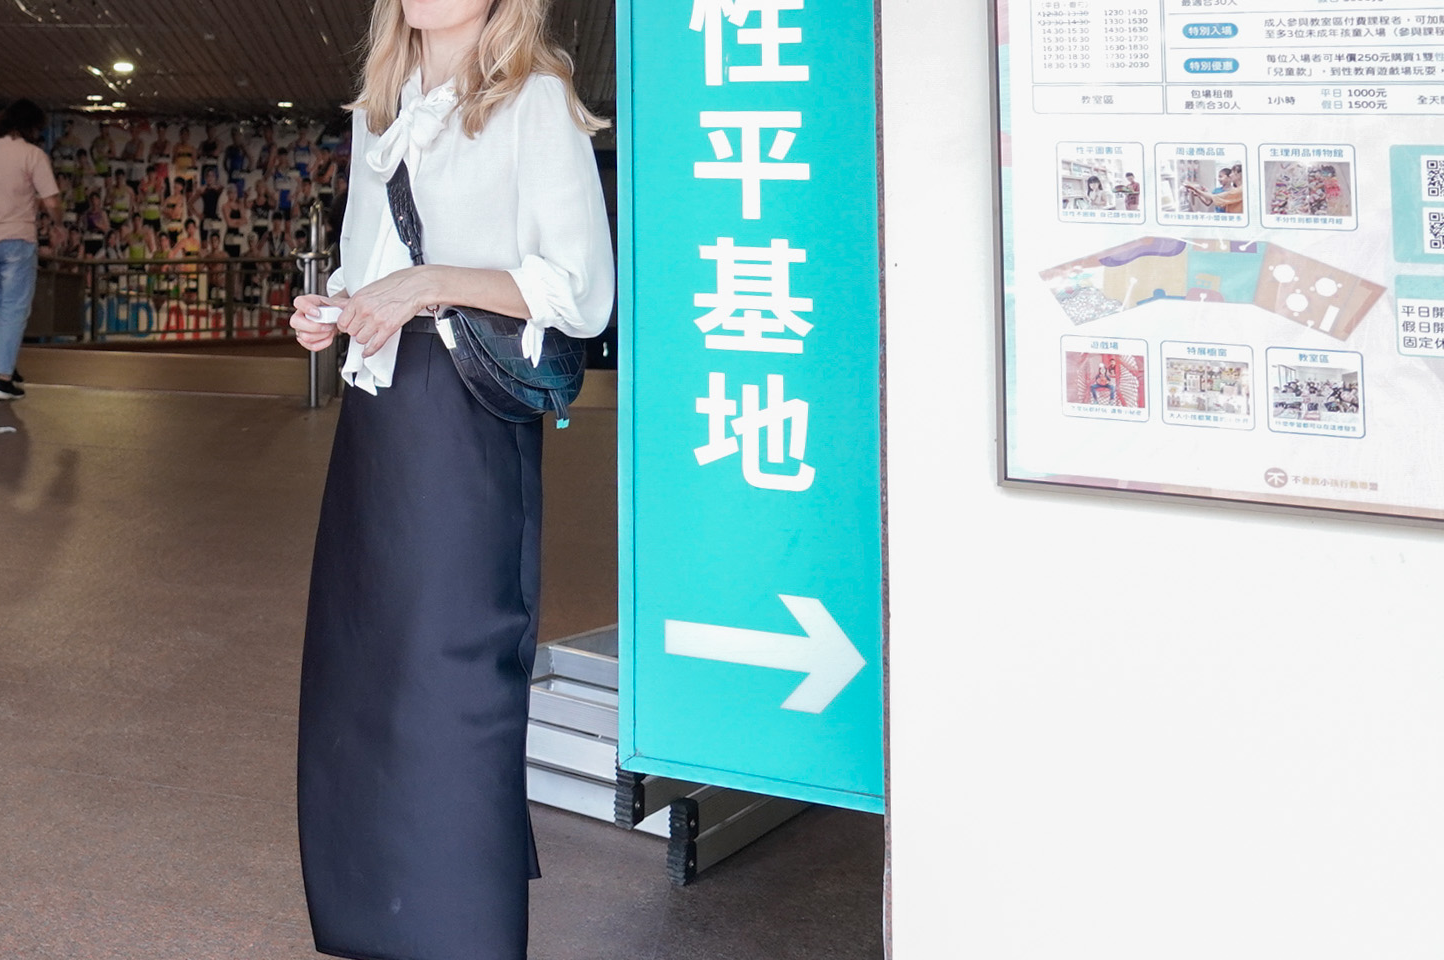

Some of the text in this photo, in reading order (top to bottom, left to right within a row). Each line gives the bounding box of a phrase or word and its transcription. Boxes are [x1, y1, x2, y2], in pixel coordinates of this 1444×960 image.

[1188, 26, 1232, 36] 特別入場
[1189, 61, 1233, 71] 特別優惠
[1191, 89, 1233, 99] 包場租借
[1321, 88, 1387, 98] 平日 1000元
[1082, 95, 1114, 104] 教室區
[1267, 96, 1295, 105] 1小時
[1417, 95, 1444, 105] 全天
[1321, 100, 1388, 110] 假日 1500元
[1270, 148, 1344, 158] 生理用品博物館
[1402, 305, 1444, 318] 平日開
[1402, 320, 1444, 333] 假日開
[1403, 335, 1444, 349] 固定休
[1298, 353, 1329, 363] 教室區
